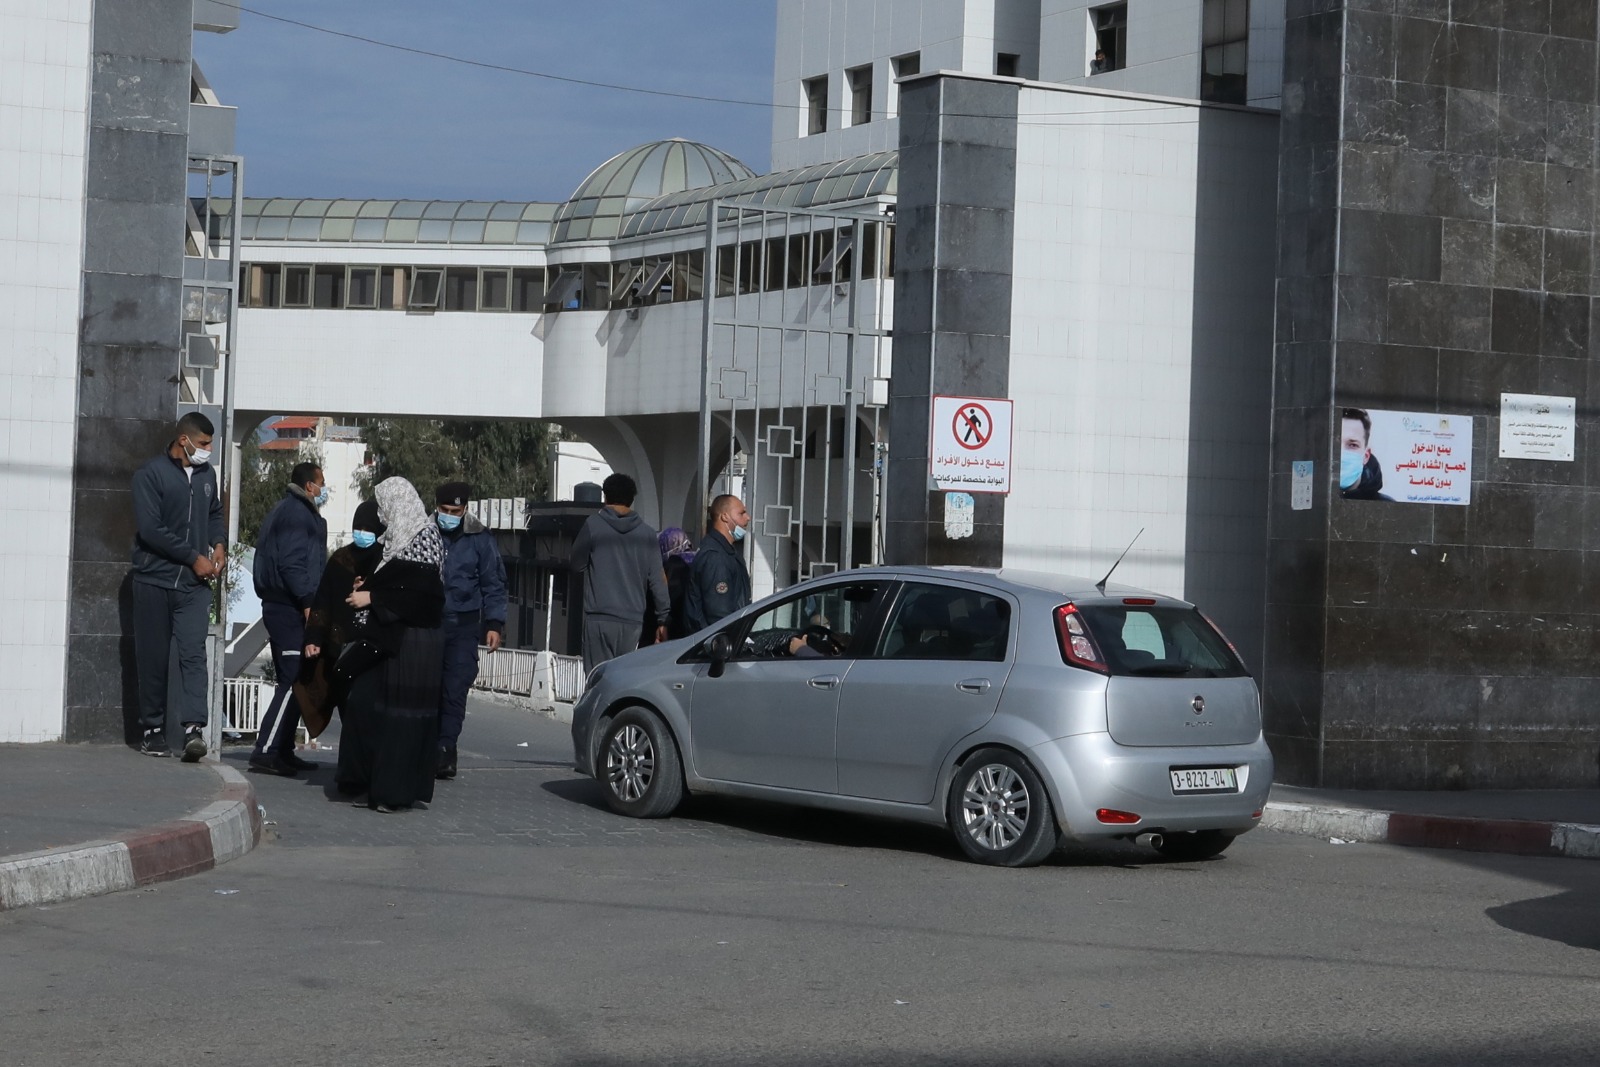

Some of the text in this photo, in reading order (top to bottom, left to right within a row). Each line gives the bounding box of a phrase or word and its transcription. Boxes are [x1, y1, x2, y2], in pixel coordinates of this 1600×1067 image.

[1412, 443, 1451, 456] يمنع الدخول
[961, 456, 984, 466] دخول
[986, 458, 1004, 469] يمنع
[1396, 459, 1466, 473] لمجمع الشفاء الطبي
[936, 474, 1004, 486] البوابة مخصصة للمركبات
[1409, 475, 1451, 490] بدون كمامة
[1174, 771, 1225, 788] 3-8232-04
